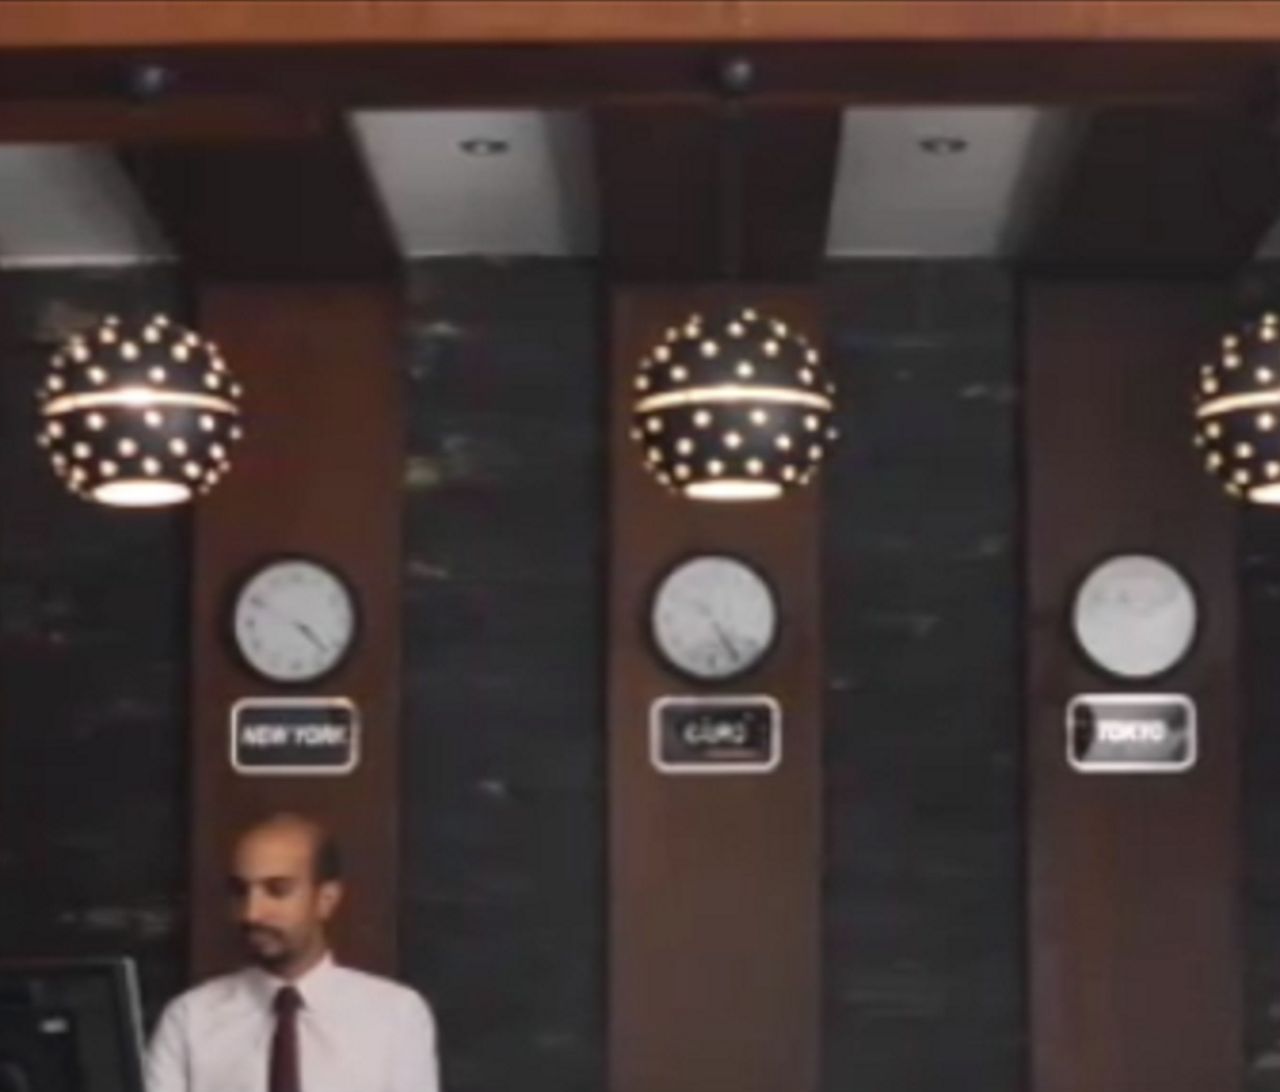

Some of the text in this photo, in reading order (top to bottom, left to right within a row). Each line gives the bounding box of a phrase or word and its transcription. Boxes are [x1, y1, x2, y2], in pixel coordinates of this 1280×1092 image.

[241, 724, 349, 747] NEW YORK
[1097, 719, 1166, 743] TOKYO
